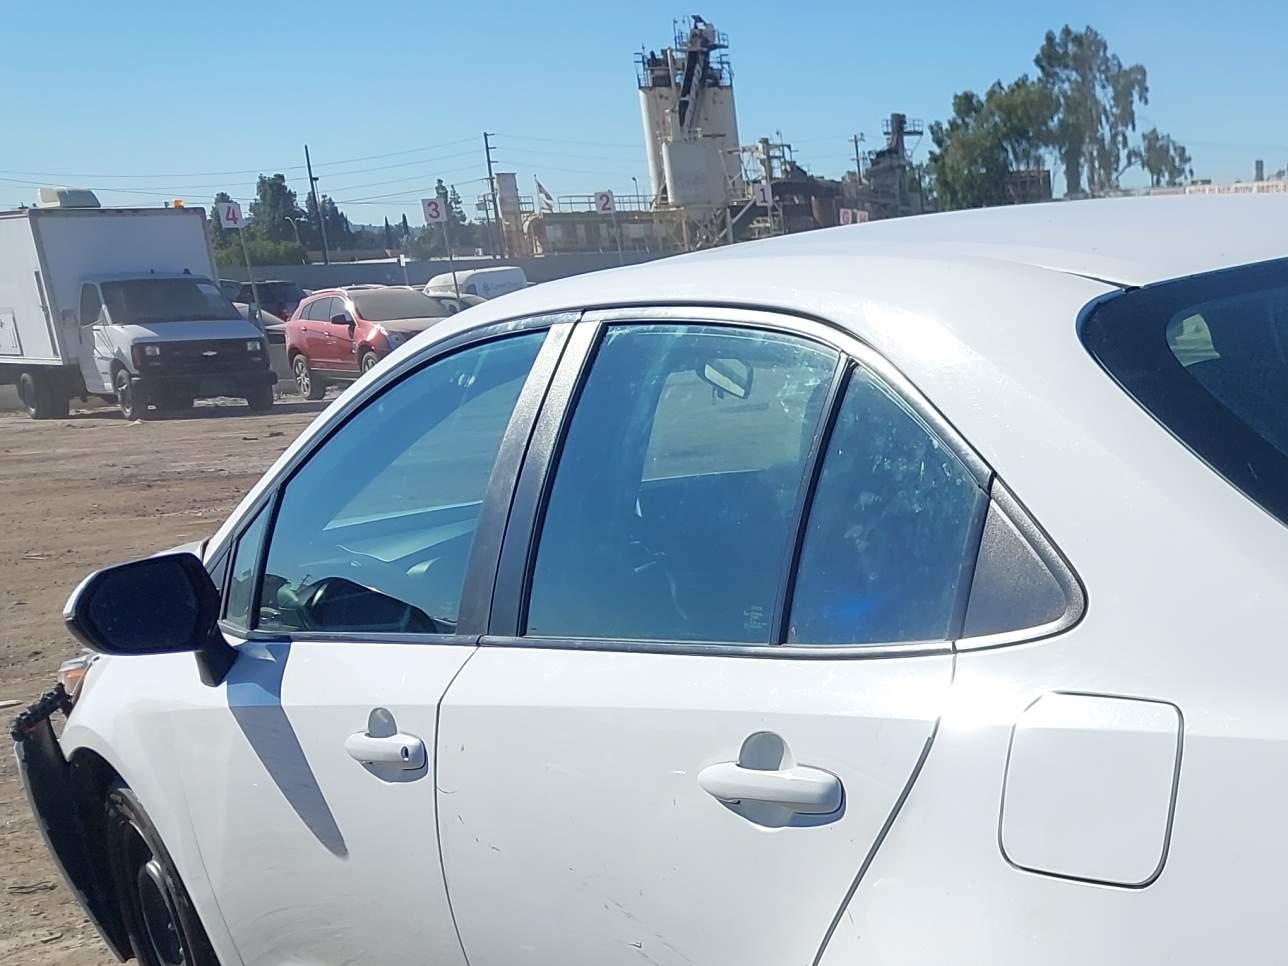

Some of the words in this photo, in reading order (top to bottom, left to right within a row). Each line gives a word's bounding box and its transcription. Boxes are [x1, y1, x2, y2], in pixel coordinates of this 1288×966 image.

[599, 193, 612, 211] 2
[760, 188, 769, 204] 1
[224, 205, 238, 225] 4
[427, 201, 440, 219] 3
